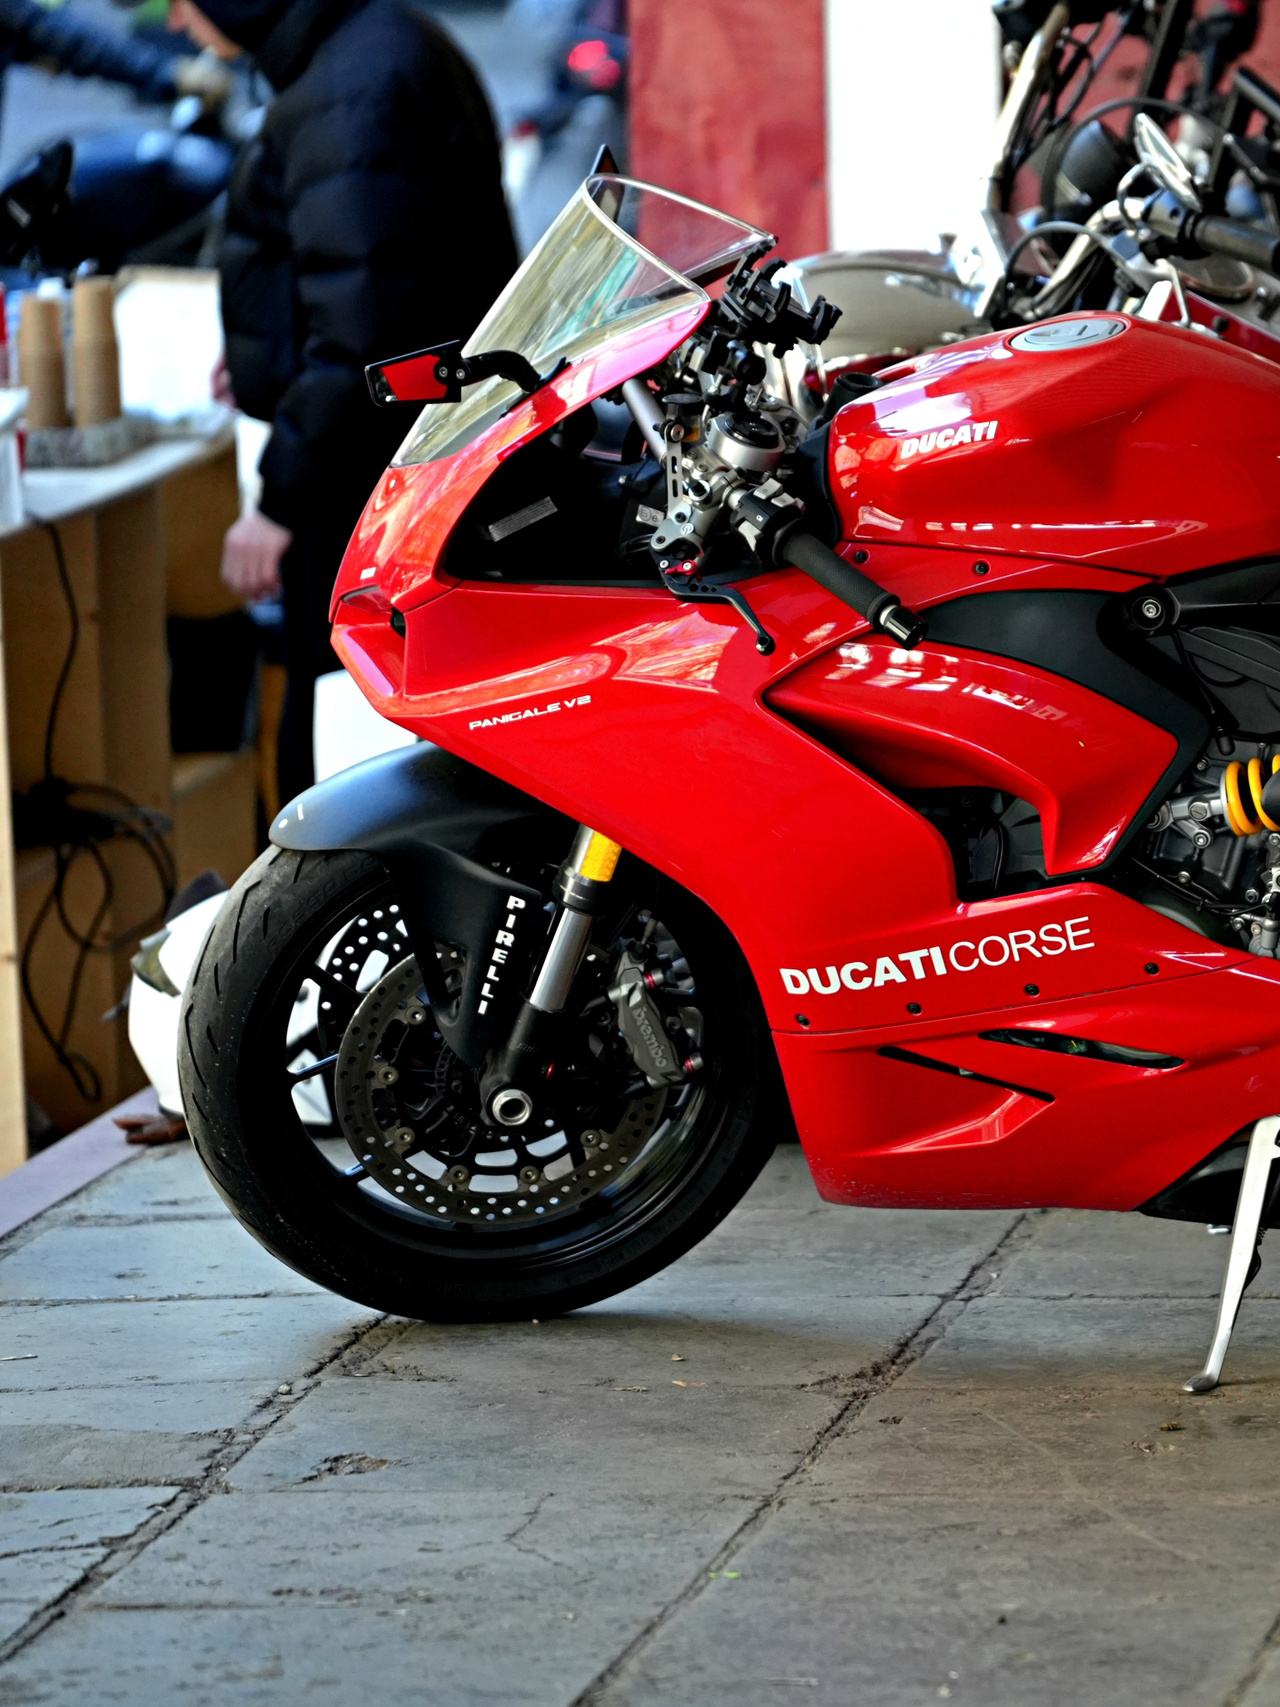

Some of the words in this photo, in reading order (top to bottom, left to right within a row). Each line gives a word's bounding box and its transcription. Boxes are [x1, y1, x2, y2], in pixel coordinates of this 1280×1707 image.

[900, 420, 998, 459] DUCATI
[469, 702, 561, 730] PANIGALE
[563, 695, 592, 708] V2
[477, 895, 526, 1015] PIRELLI
[779, 946, 948, 995] DUCATI
[949, 916, 1095, 972] CORSE
[632, 1006, 668, 1068] brembo
